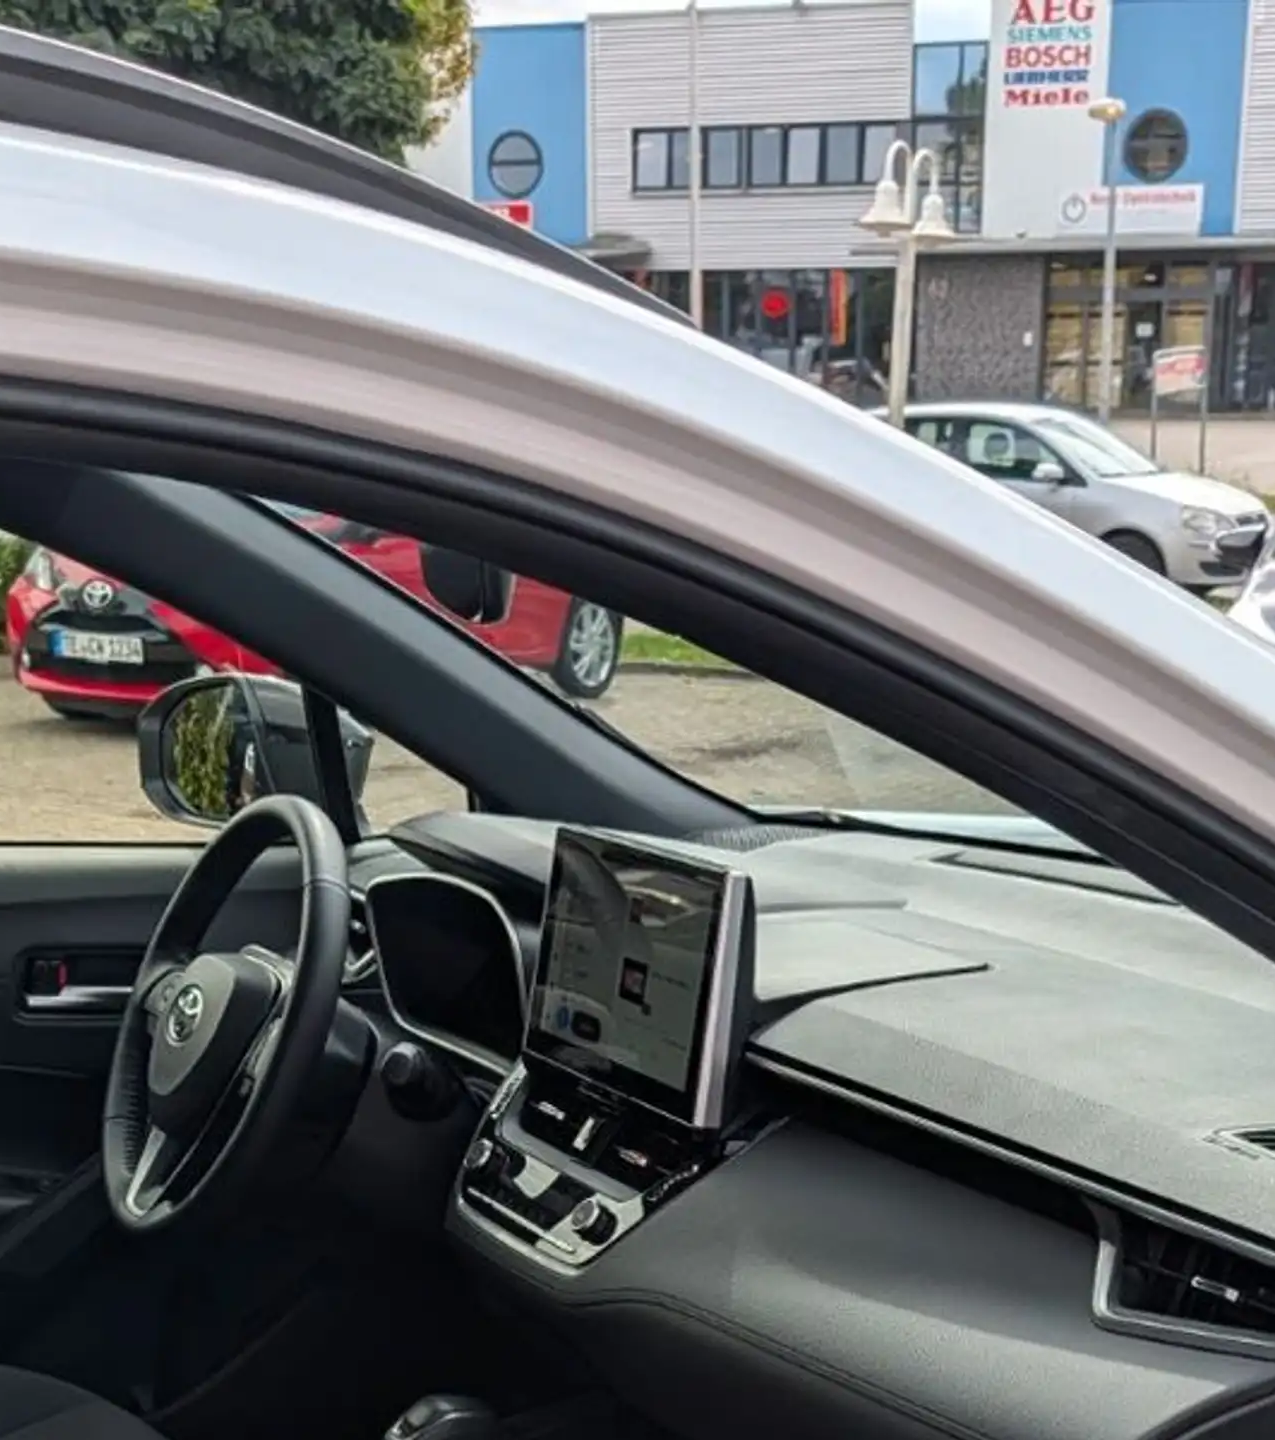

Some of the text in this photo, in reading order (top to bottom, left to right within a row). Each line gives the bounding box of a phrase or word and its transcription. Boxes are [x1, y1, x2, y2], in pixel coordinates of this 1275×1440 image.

[1010, 0, 1094, 24] AEG
[1007, 26, 1092, 42] SIEMENS
[1005, 44, 1092, 68] BOSCH
[1004, 88, 1089, 107] Miele
